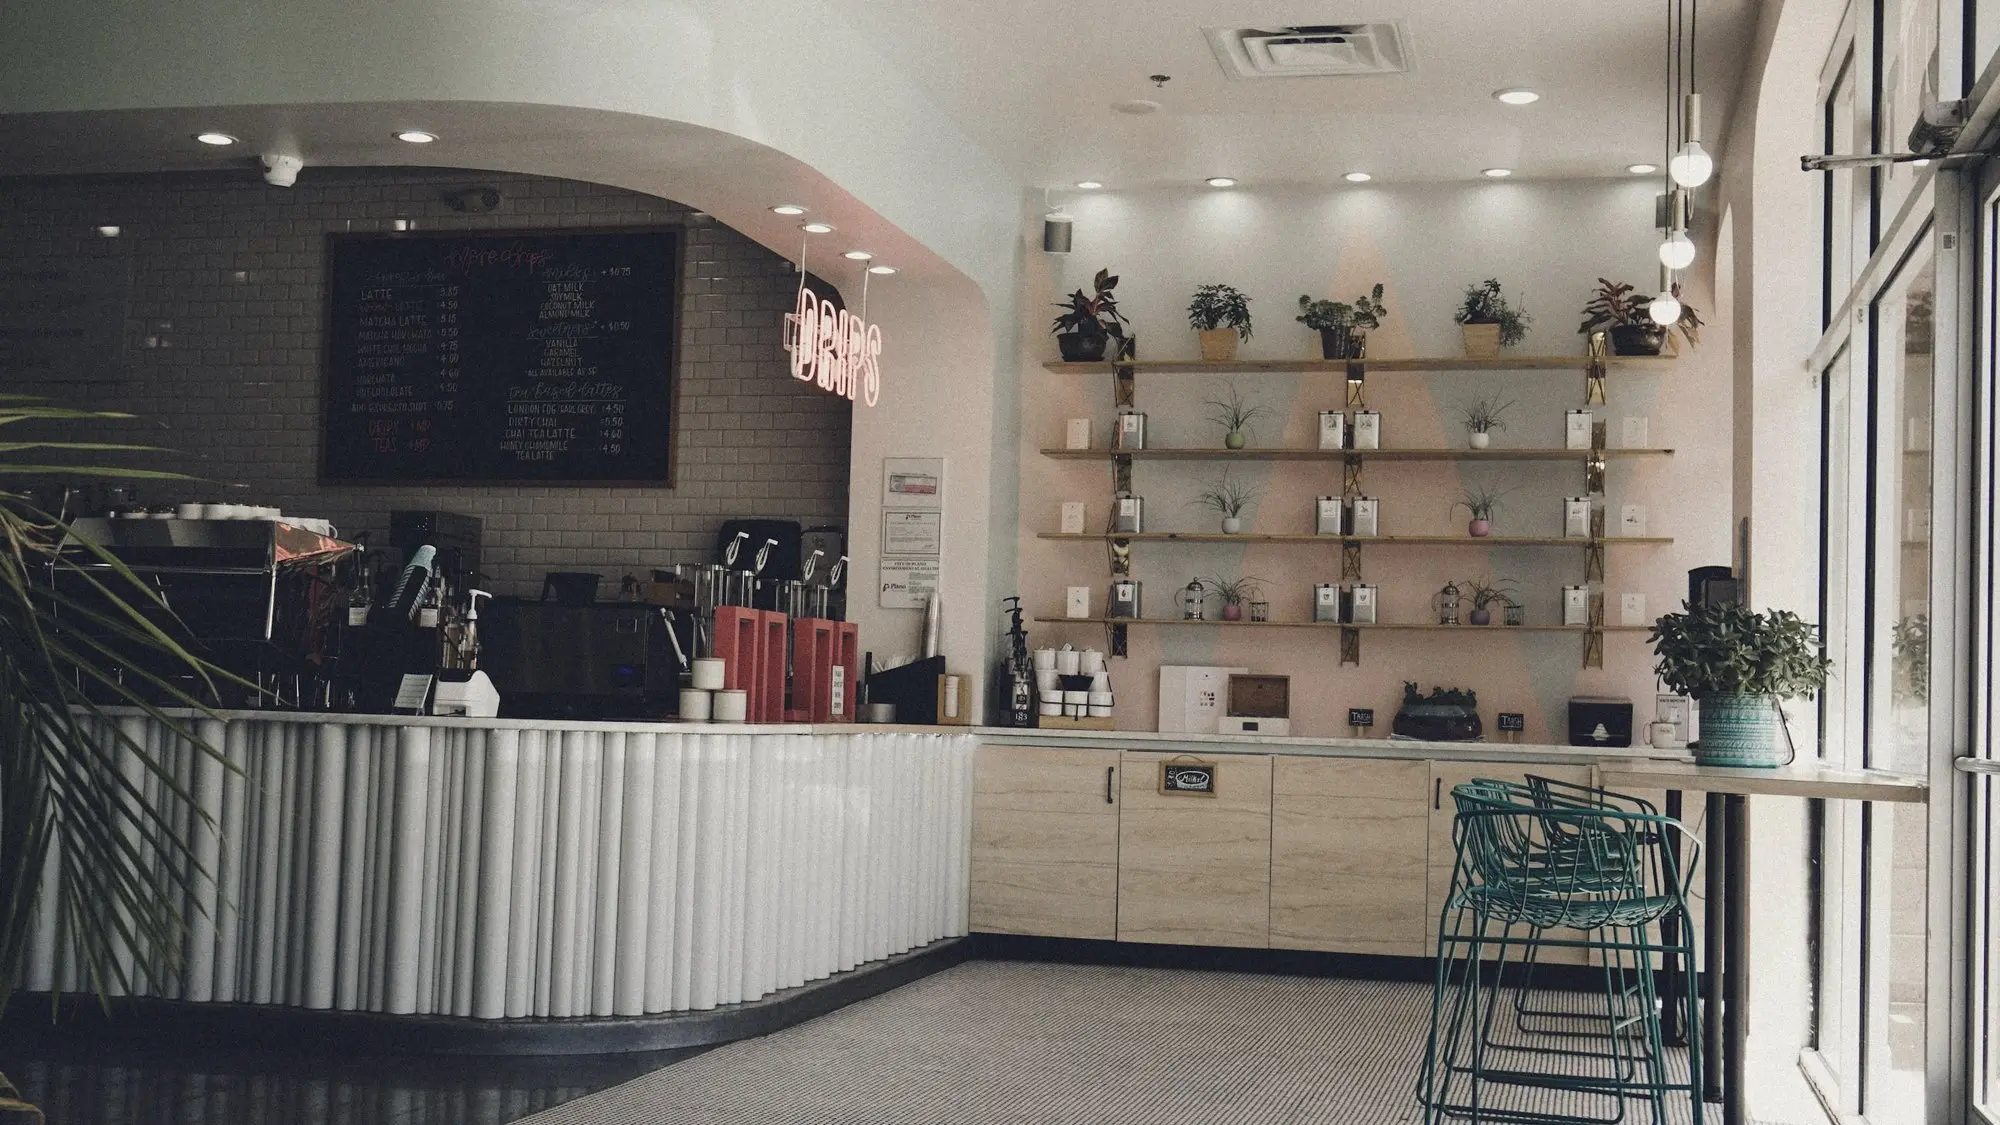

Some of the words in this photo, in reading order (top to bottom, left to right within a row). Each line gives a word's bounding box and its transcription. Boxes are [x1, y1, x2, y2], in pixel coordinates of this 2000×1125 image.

[548, 283, 561, 293] OAT
[563, 282, 584, 292] MILK
[361, 288, 392, 300] LATTE
[573, 300, 596, 309] MILK
[571, 309, 592, 318] MILK
[359, 316, 396, 327] MATCHA
[398, 315, 427, 327] LATTE
[545, 338, 578, 348] VANILLA
[791, 287, 882, 407] DRIPS
[543, 348, 577, 357] CARAMEL
[540, 357, 583, 367] HAZELNUT
[539, 368, 574, 376] AVAILABLE
[508, 404, 539, 414] LONDON
[541, 404, 557, 414] FOG
[508, 417, 535, 428] DIRTY
[537, 417, 557, 427] CHAI
[505, 429, 525, 440] CHAI
[528, 429, 546, 440] TEA
[546, 428, 577, 439] LATTE
